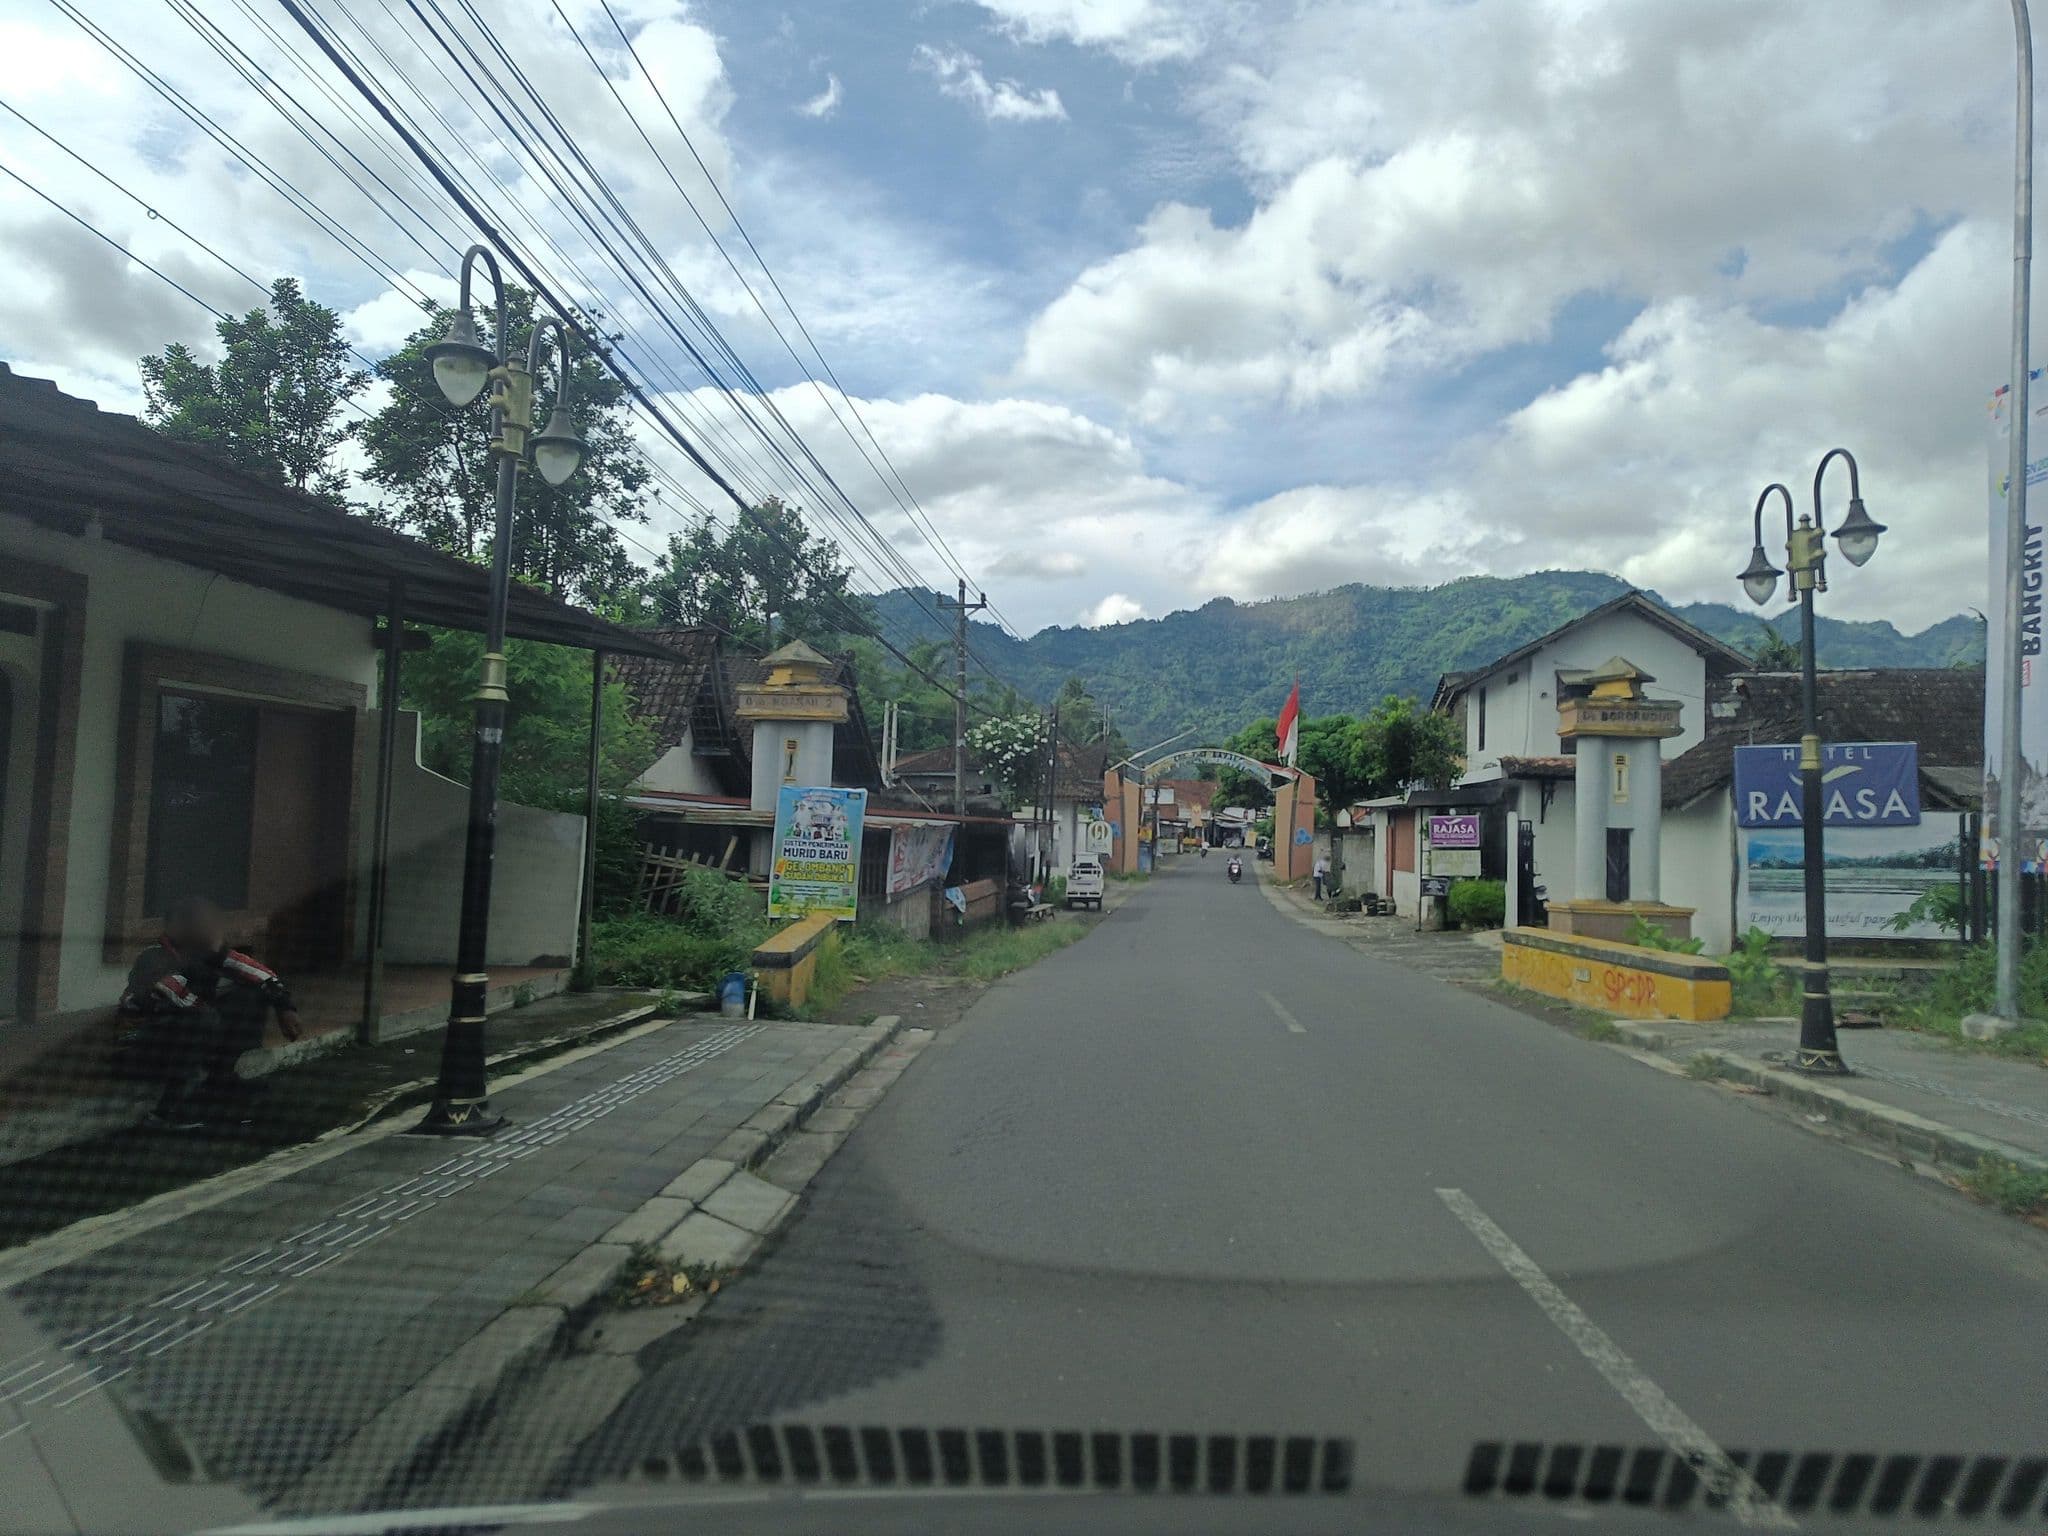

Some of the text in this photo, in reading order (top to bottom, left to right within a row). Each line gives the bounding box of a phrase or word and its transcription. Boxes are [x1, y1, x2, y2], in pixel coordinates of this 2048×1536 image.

[1782, 747, 1873, 760] HTEL
[1749, 788, 1912, 821] RAASA
[1433, 824, 1475, 834] RAJASA
[783, 847, 848, 860] MURID BARU
[1751, 912, 1783, 926] Enjoy
